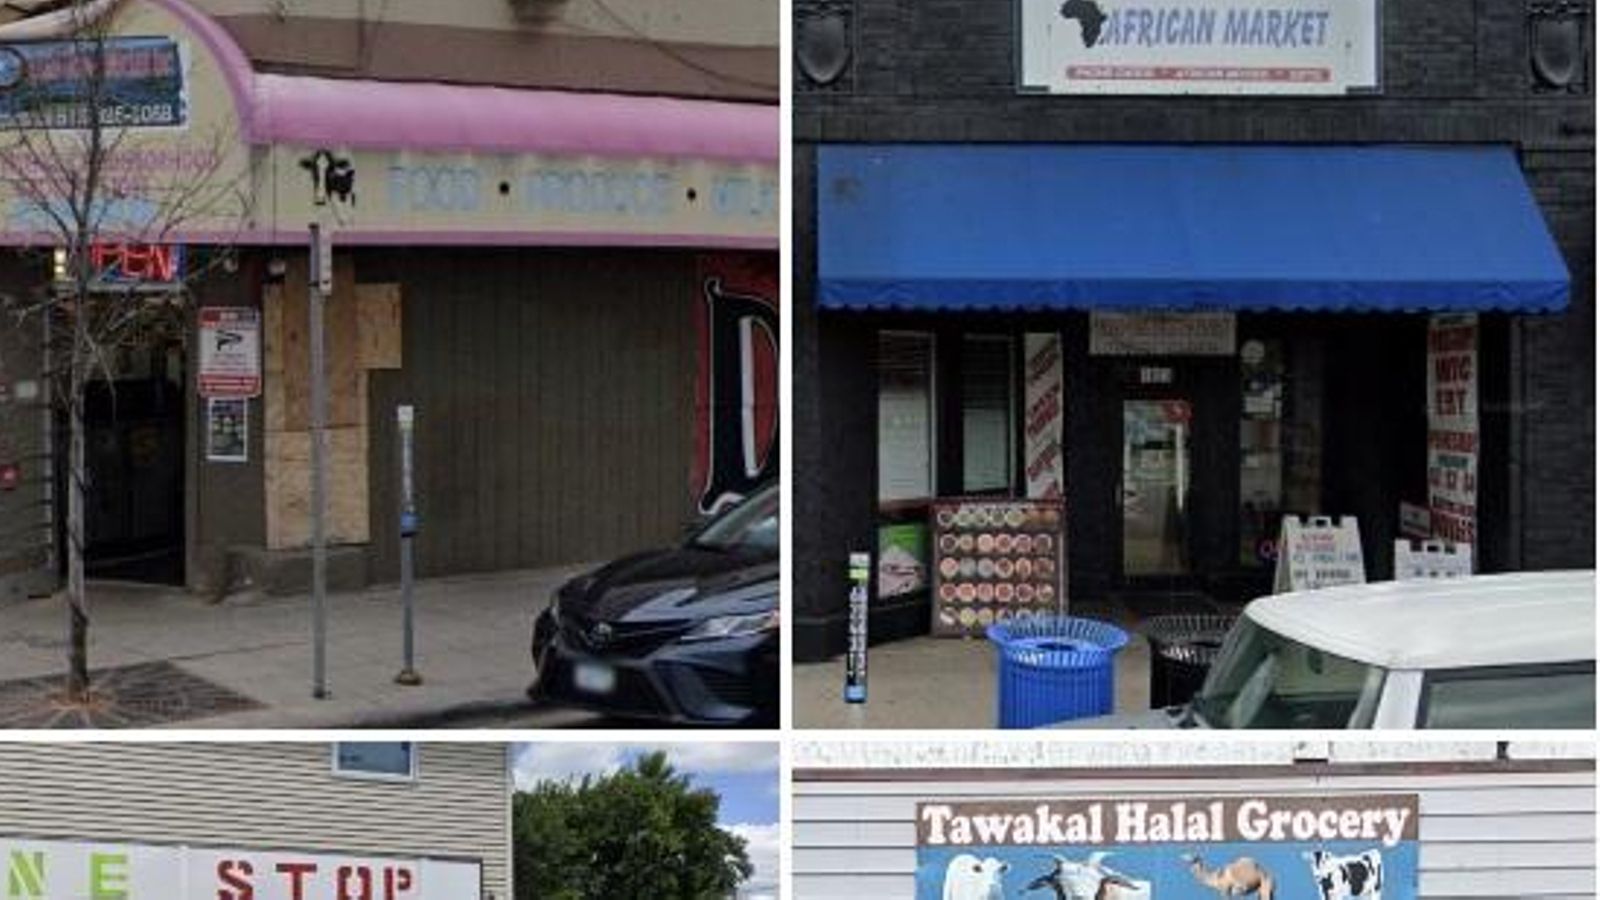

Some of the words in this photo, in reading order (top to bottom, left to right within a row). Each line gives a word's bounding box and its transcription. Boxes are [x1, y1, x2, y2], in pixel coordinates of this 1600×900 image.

[1103, 9, 1214, 47] AFRICAN
[1222, 10, 1330, 48] MARKET
[389, 166, 479, 212] FOOD
[1435, 355, 1472, 383] WIC
[922, 803, 1105, 845] Tawakal
[1116, 802, 1225, 842] Halal
[1237, 801, 1413, 848] Grocery
[216, 859, 413, 900] STOP
